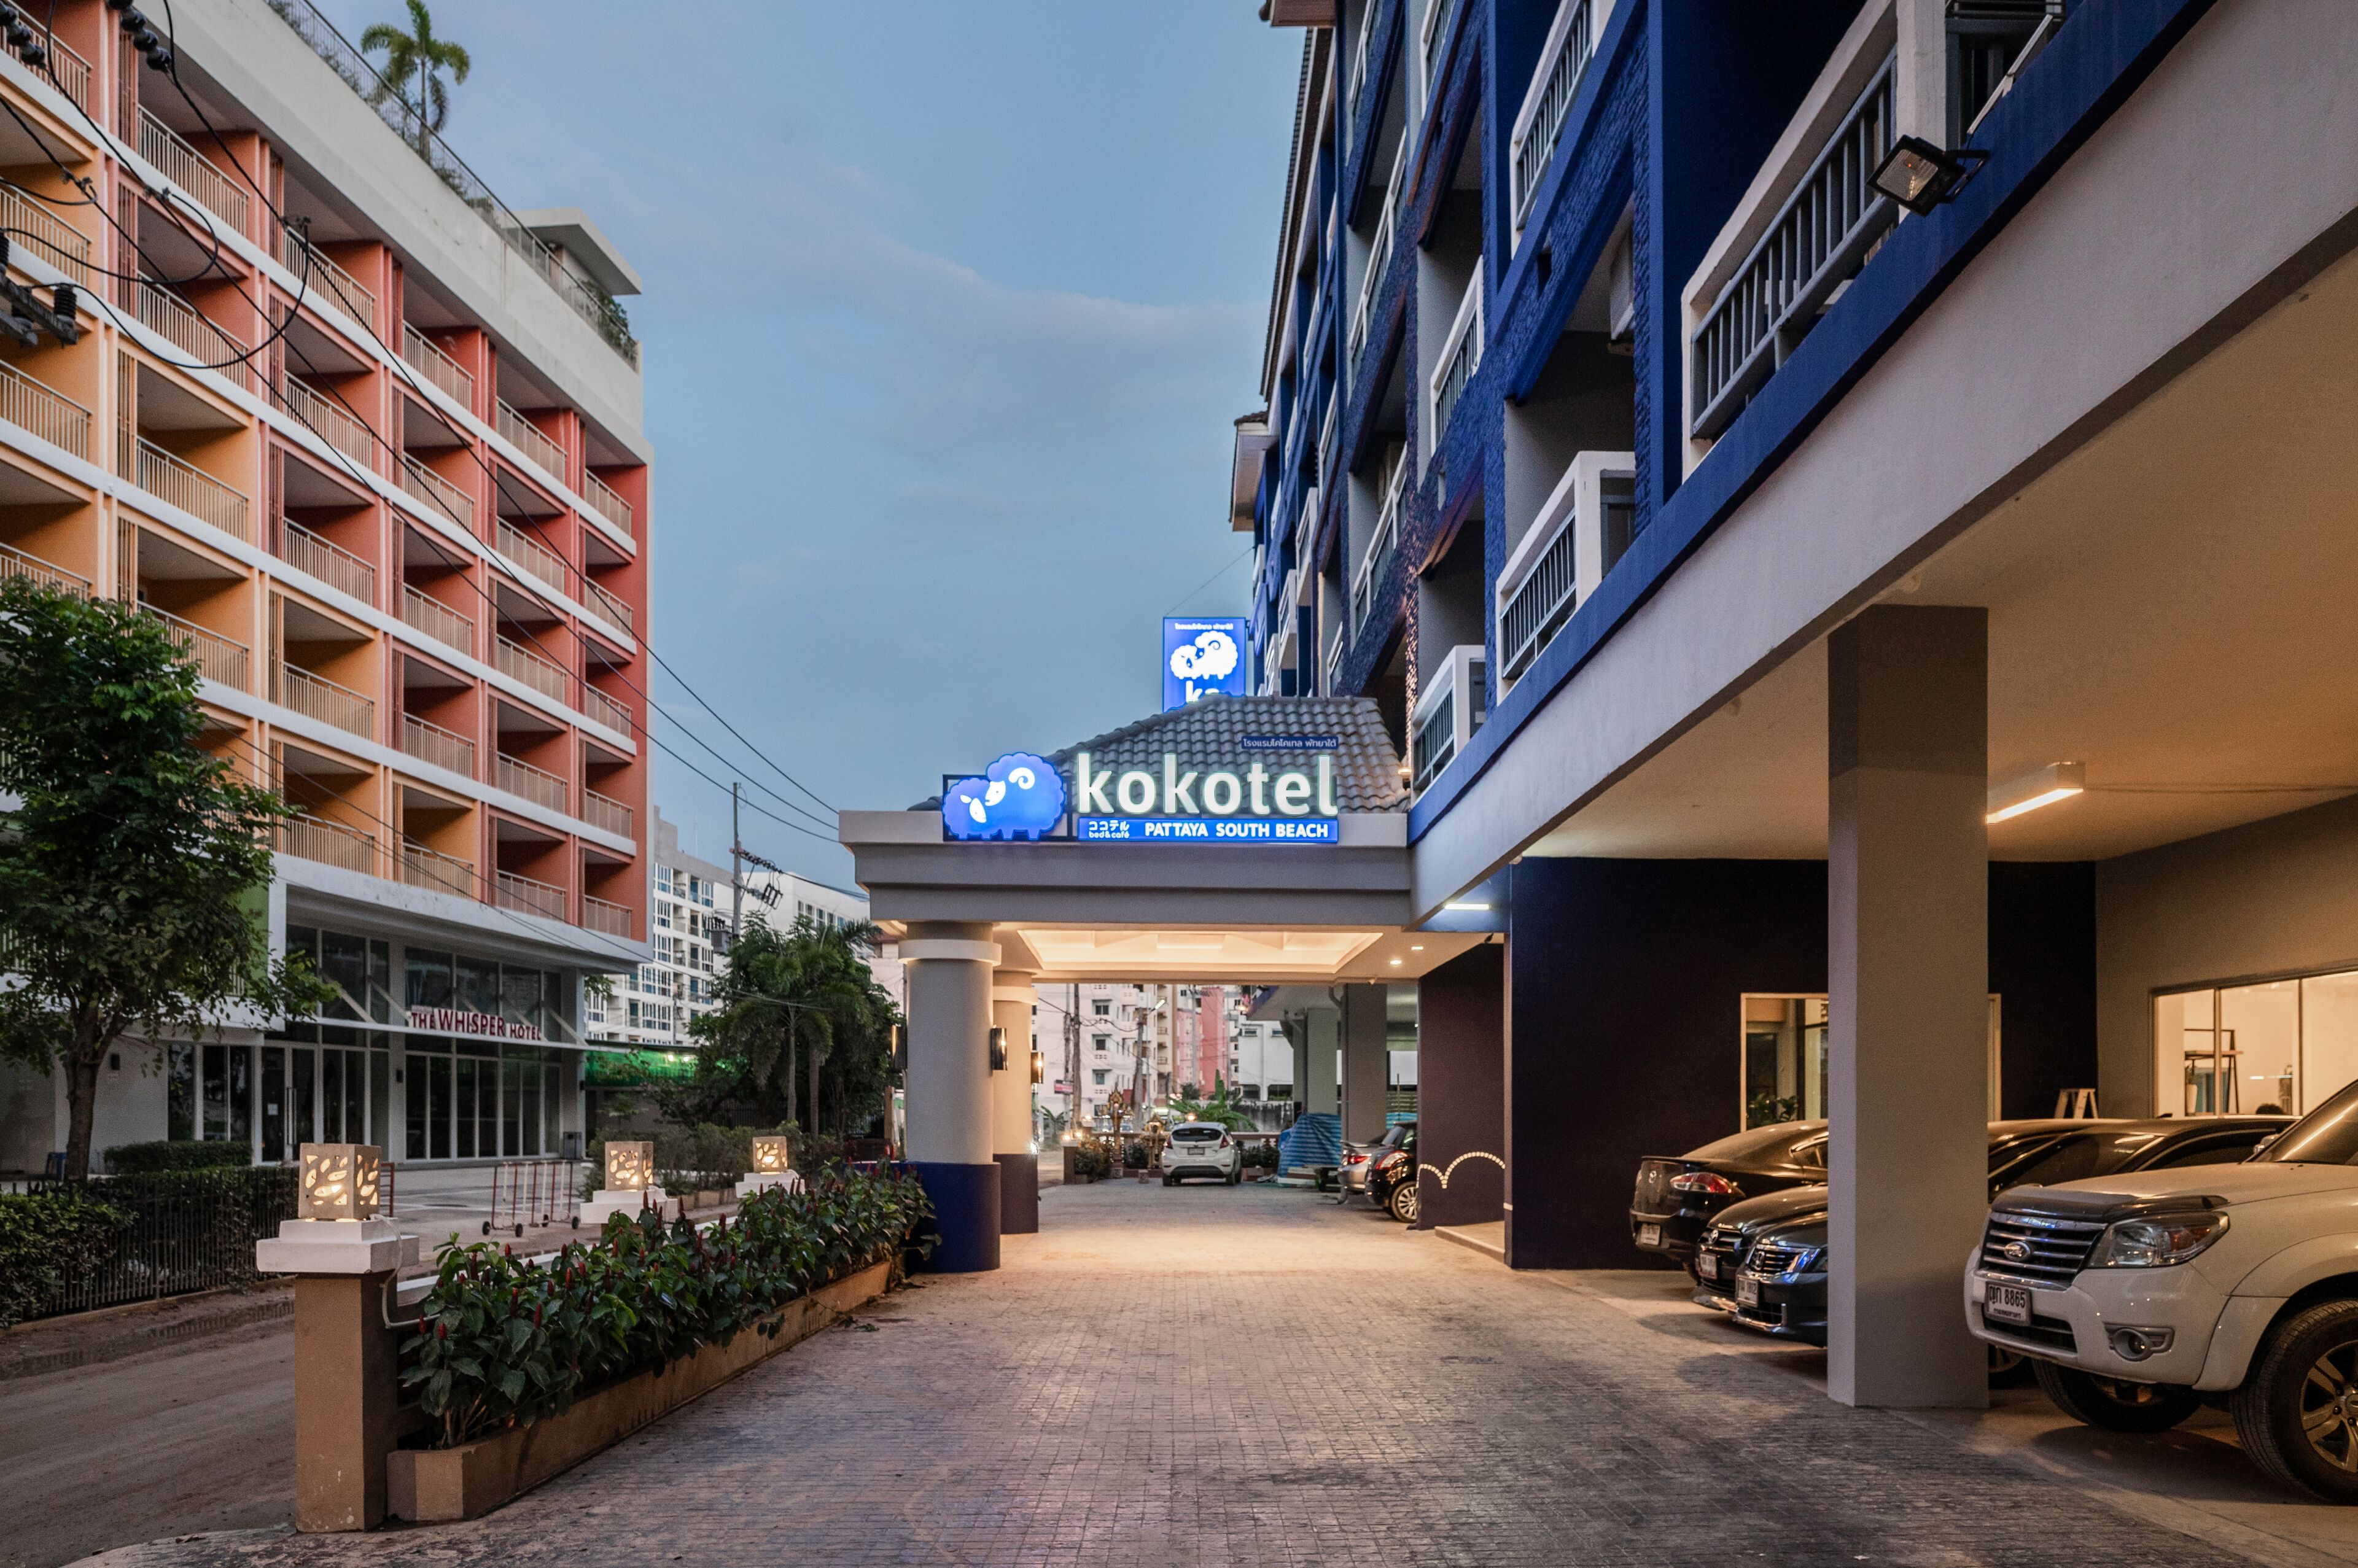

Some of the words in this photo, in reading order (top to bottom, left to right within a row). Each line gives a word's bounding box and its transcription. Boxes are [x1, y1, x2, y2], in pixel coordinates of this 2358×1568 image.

[1077, 753, 1338, 816] kokotel
[1089, 820, 1130, 831] ココテル
[1145, 823, 1208, 837] PATTAYA
[1216, 823, 1270, 837] SOUTH
[1276, 823, 1328, 838] BEACH
[411, 1012, 436, 1030] THE
[438, 1009, 505, 1037] WHISPER
[510, 1023, 542, 1041] HOTEL
[2004, 1289, 2025, 1308] 8865
